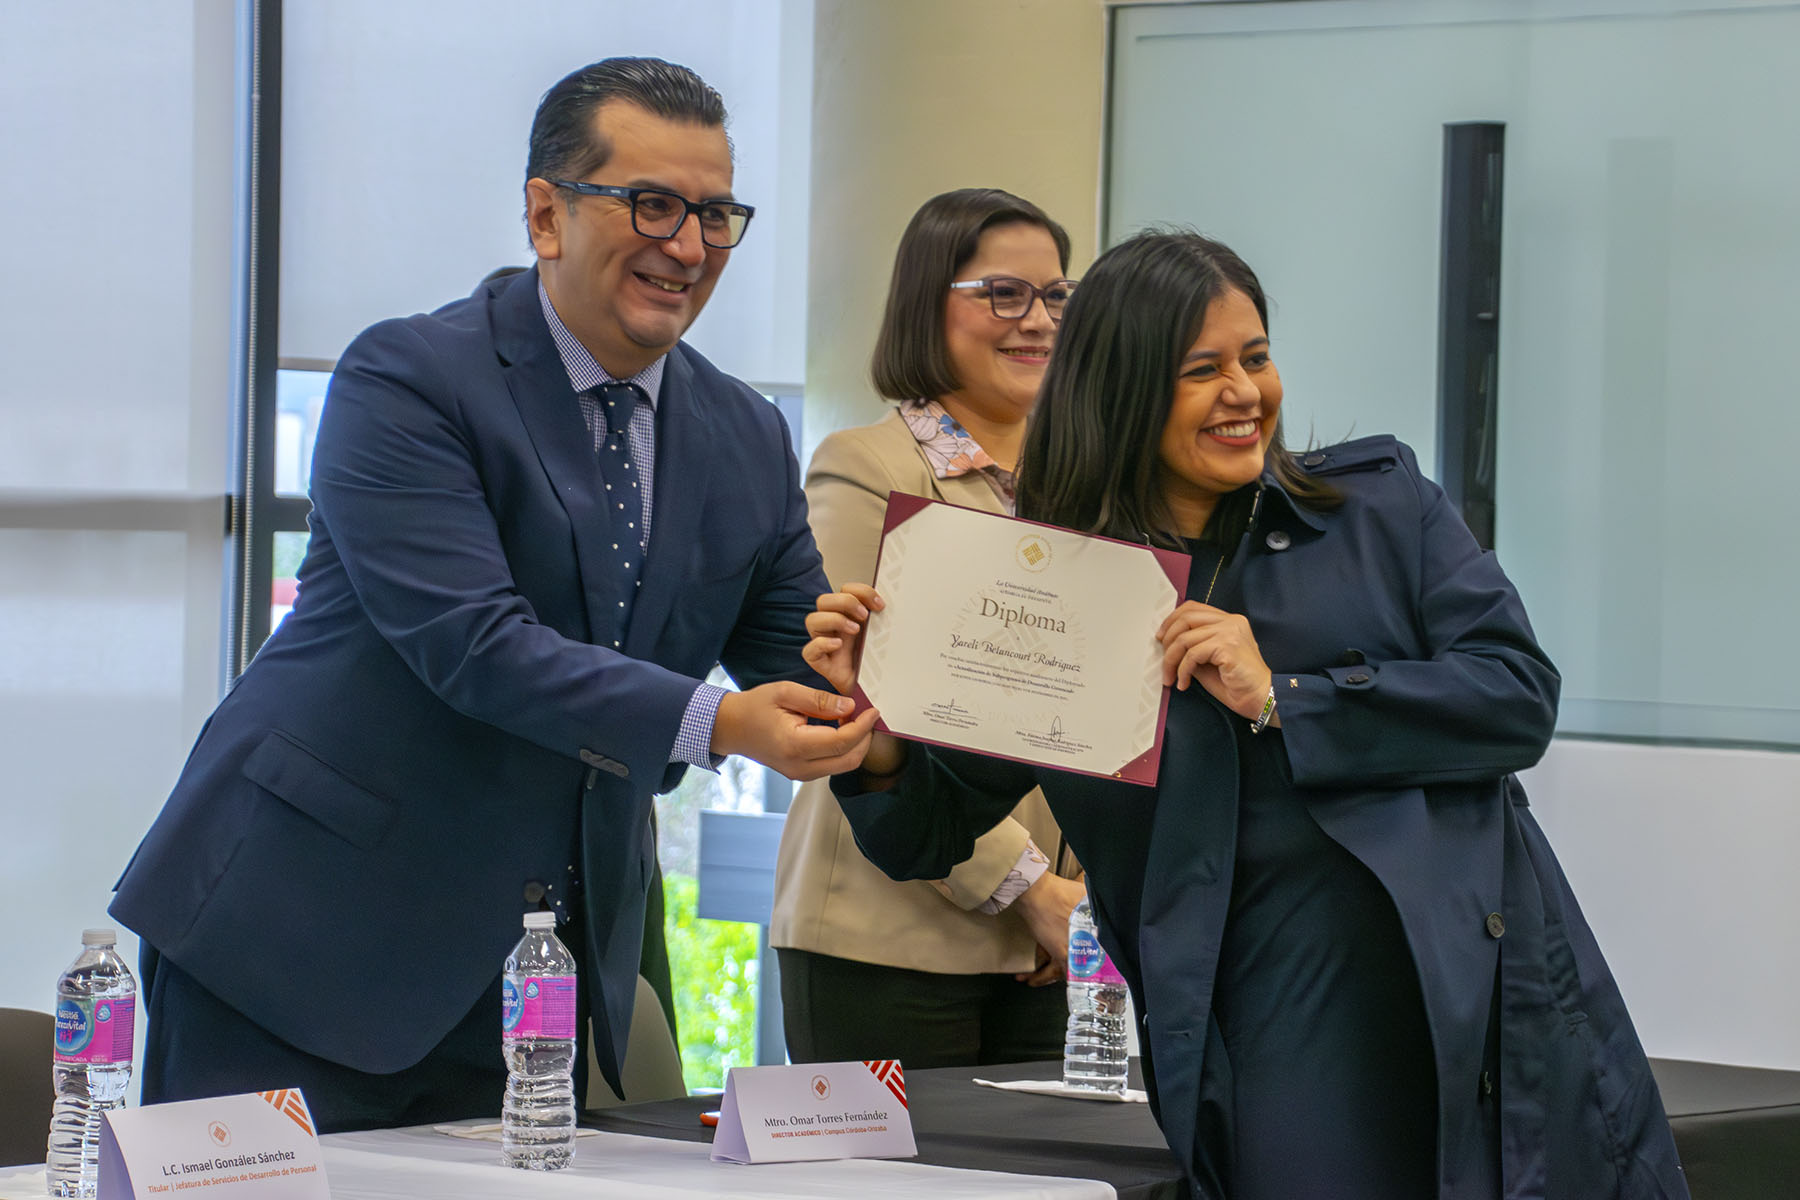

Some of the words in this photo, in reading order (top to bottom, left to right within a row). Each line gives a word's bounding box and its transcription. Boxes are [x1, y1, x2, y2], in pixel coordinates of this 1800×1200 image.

[979, 597, 1067, 634] Diploma
[951, 633, 980, 650] Yareli
[981, 640, 1032, 662] Betancourt
[764, 1117, 789, 1127] Mtro.
[789, 1115, 815, 1126] Omar
[816, 1114, 844, 1124] Torres
[844, 1110, 889, 1122] Fernández
[162, 1164, 181, 1177] L.C.
[181, 1159, 214, 1174] Ismael
[214, 1154, 257, 1170] González
[257, 1149, 296, 1164] Sánchez
[147, 1184, 169, 1193] Titular
[175, 1179, 202, 1191] Jefatura
[202, 1177, 211, 1187] de
[211, 1174, 240, 1186] Servicios
[239, 1173, 249, 1181] de
[248, 1168, 281, 1180] Desarrollo
[281, 1167, 290, 1176] de
[290, 1163, 318, 1175] Personal
